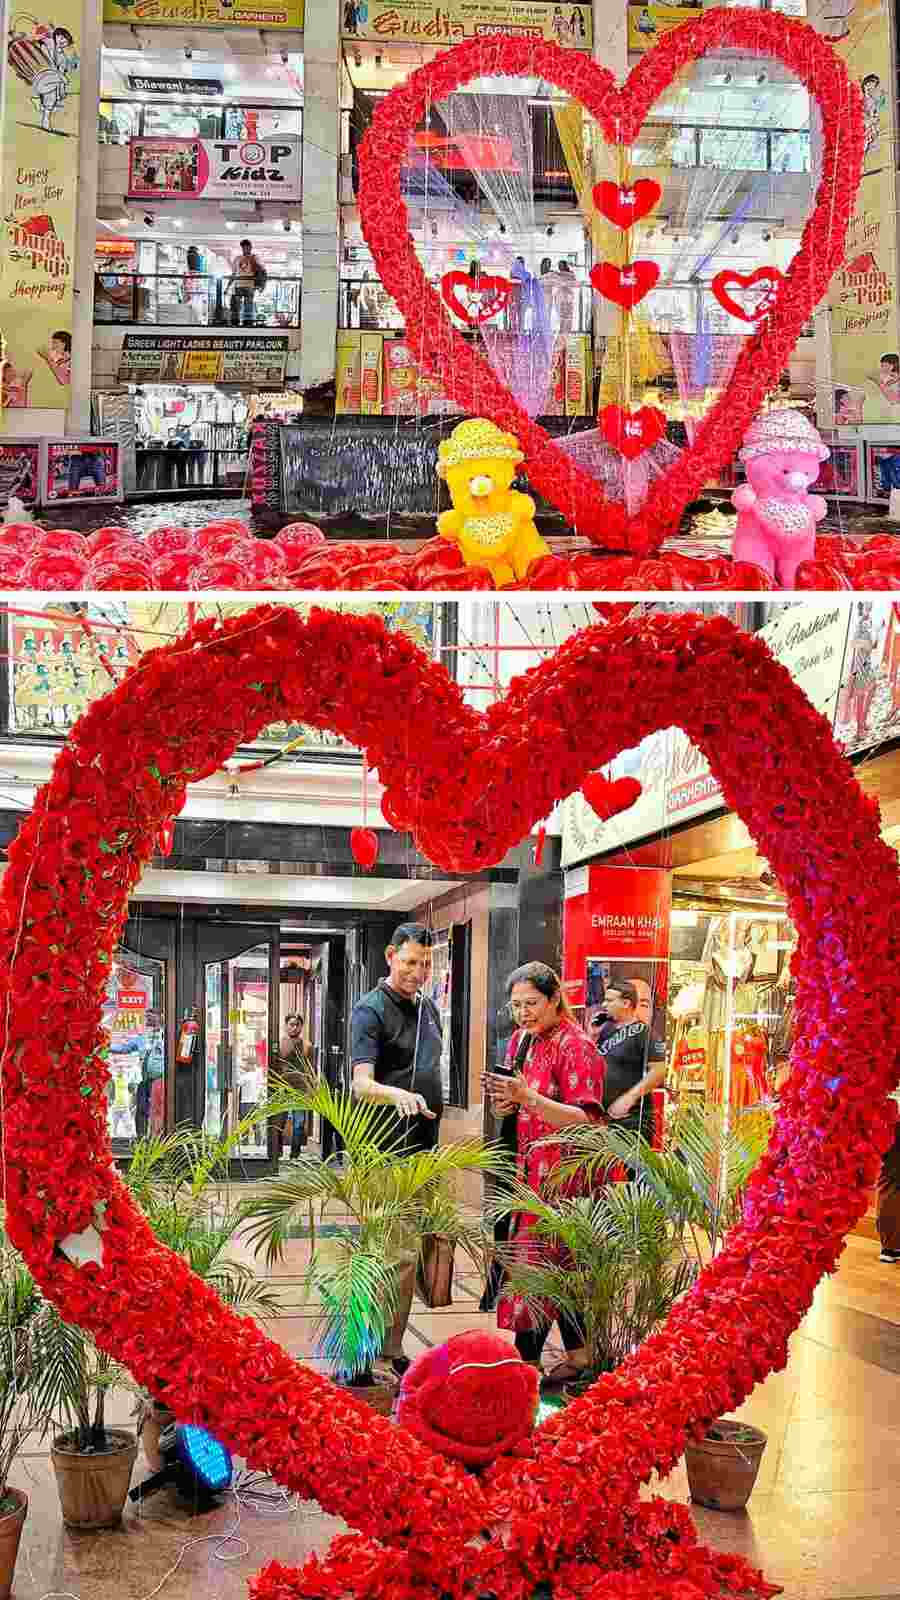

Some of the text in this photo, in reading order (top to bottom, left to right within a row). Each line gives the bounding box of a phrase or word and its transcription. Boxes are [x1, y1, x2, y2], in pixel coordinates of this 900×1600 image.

[214, 143, 292, 166] TOP
[16, 167, 49, 185] Enjoy
[220, 166, 285, 181] Kidz
[9, 280, 65, 302] Shopping
[127, 336, 284, 350] GREEN LIGHT LADIES BEAUTY PARLOUR
[591, 913, 635, 928] EMRAAN
[120, 996, 145, 1005] EXIT
